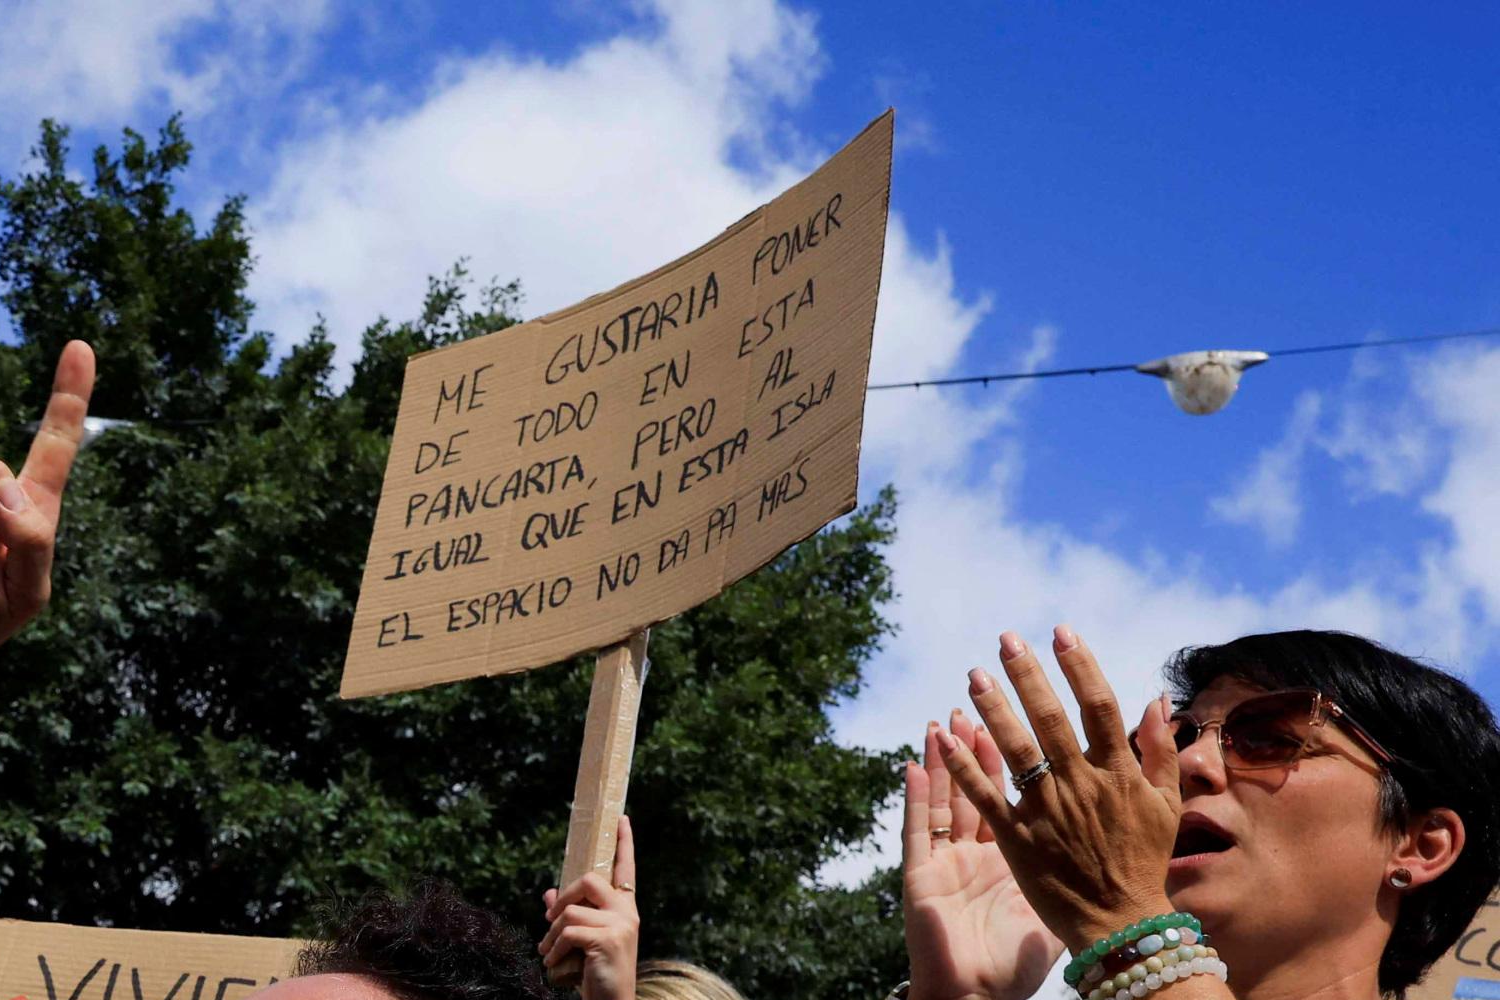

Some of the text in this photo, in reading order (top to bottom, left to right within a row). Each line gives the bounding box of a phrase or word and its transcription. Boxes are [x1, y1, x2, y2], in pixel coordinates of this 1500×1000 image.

[414, 278, 815, 475] DE TODO EN ESTA
[433, 193, 843, 425] ME GUSTARIA PONER
[383, 369, 837, 582] IGUAL QUE EN ESTA ISLA
[405, 347, 800, 529] PANCARTA, PERO AL
[377, 612, 425, 648] EL
[446, 576, 574, 633] ESPACIO
[598, 553, 641, 602] NO
[657, 529, 691, 575] DA
[705, 502, 738, 555] PA
